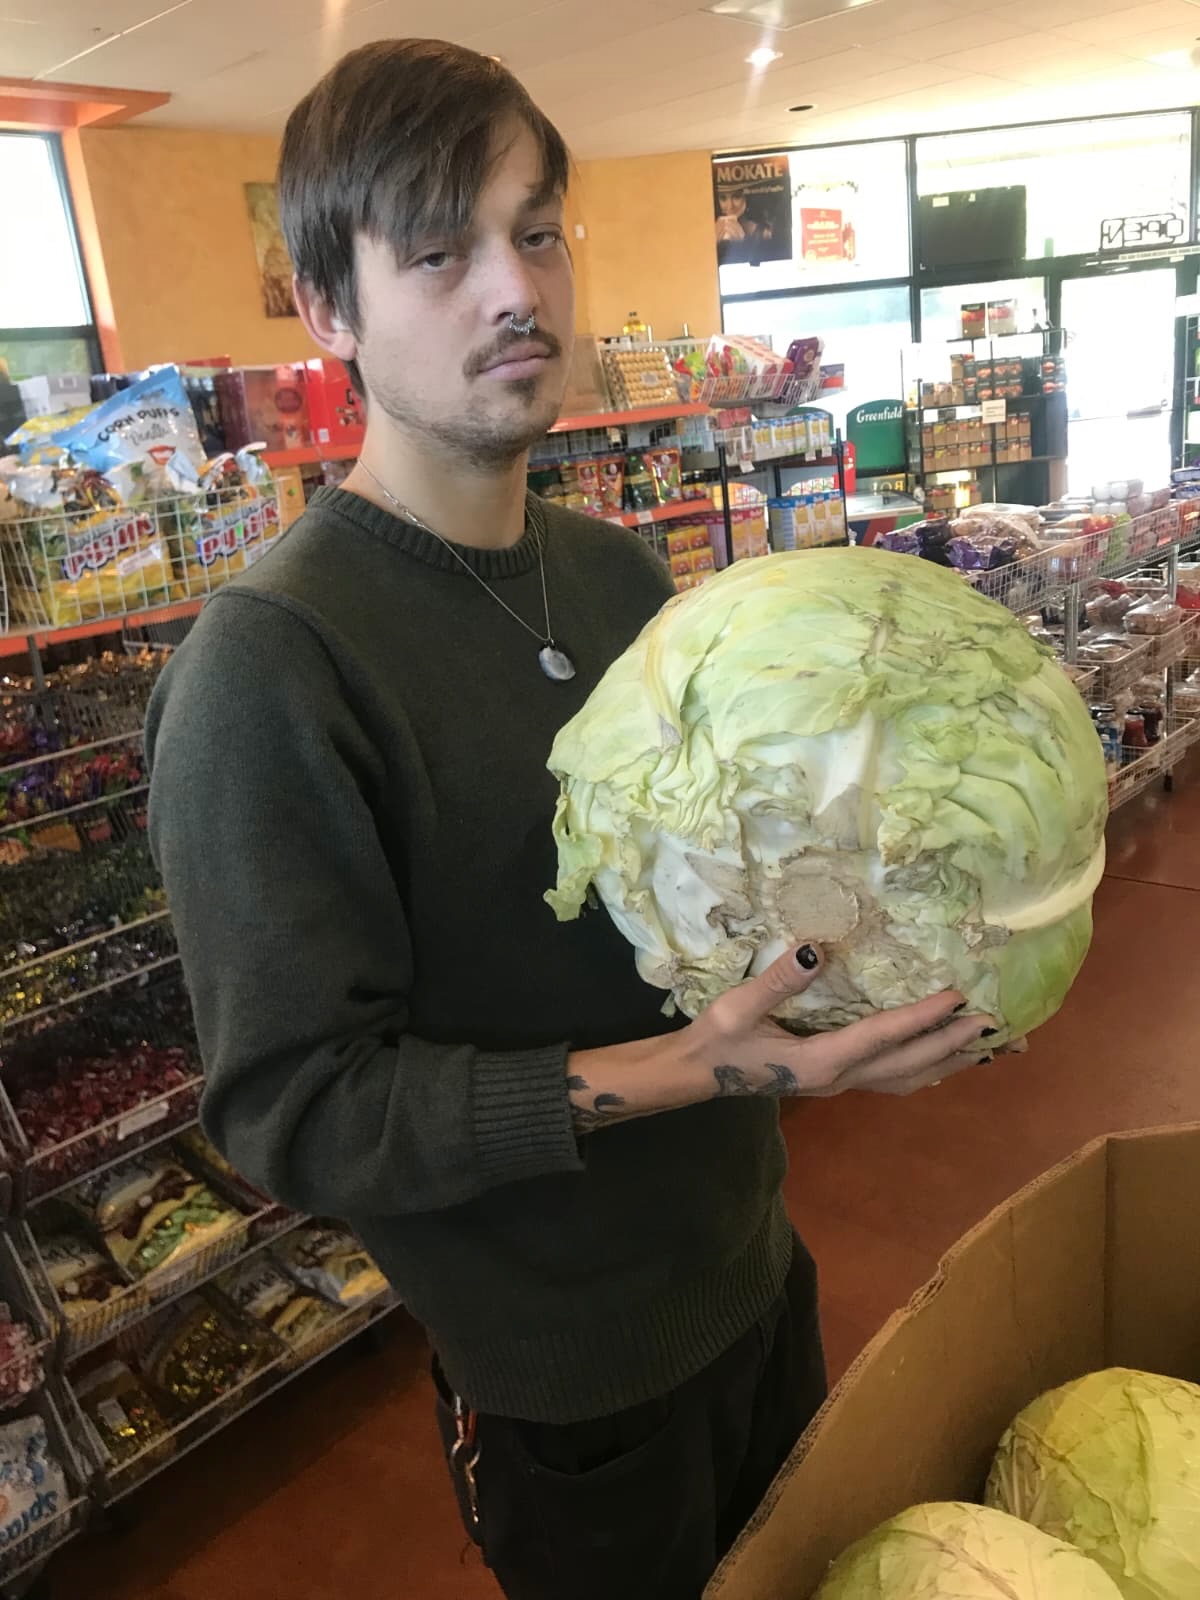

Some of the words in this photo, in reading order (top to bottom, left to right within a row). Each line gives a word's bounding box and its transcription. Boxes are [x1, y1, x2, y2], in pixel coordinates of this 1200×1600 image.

[717, 162, 783, 183] MOKATE
[856, 405, 903, 424] Greenfield
[97, 415, 135, 442] CORN
